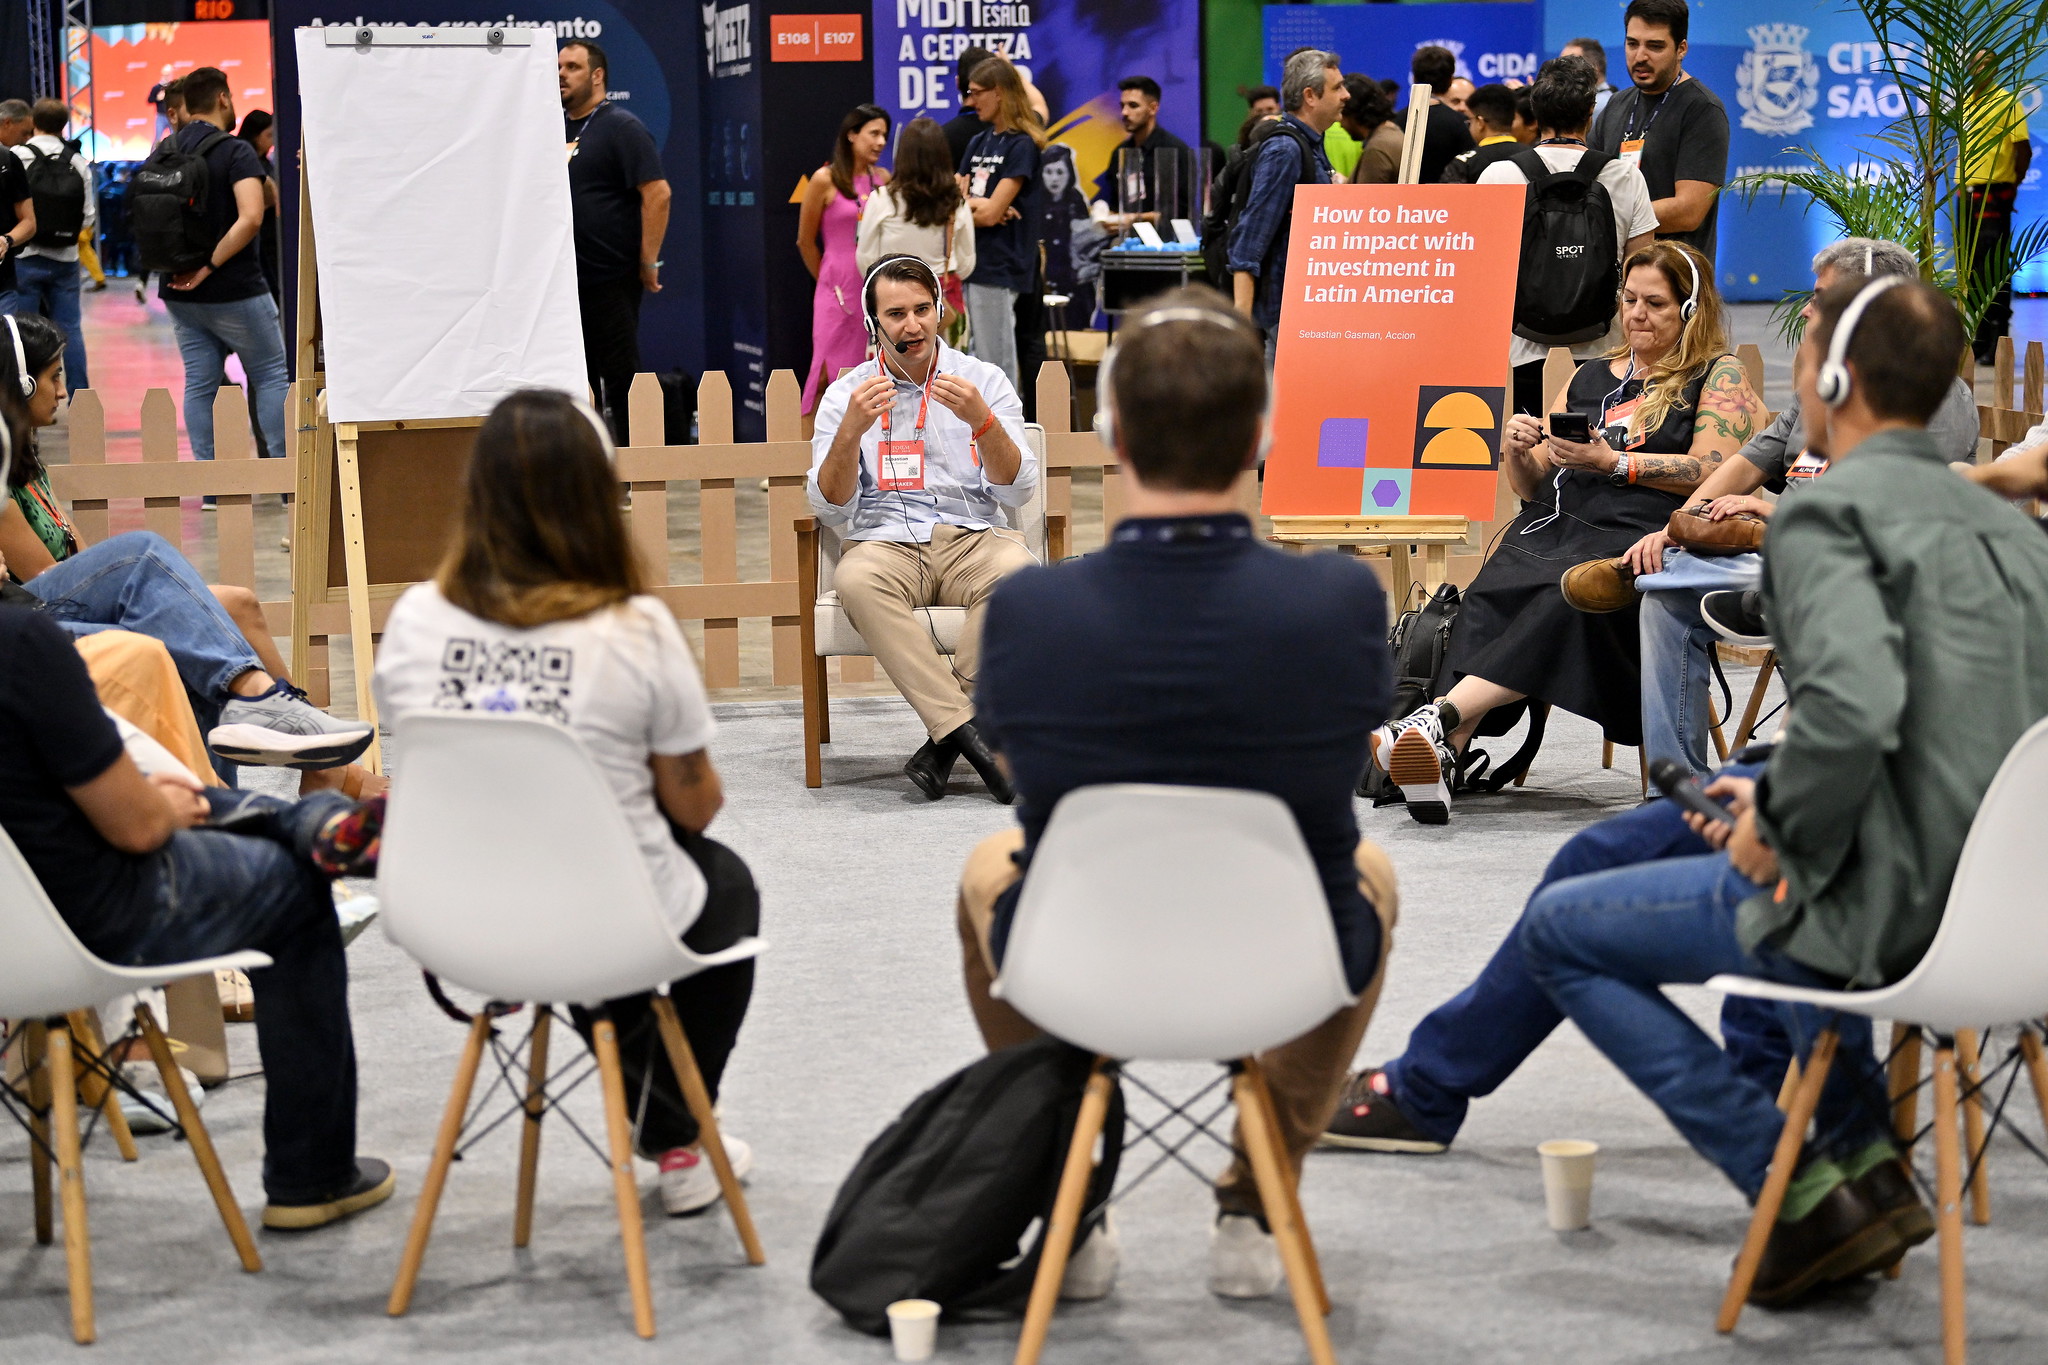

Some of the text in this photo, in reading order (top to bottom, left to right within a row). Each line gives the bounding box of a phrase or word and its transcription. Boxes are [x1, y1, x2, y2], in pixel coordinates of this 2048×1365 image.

[195, 0, 235, 19] RIO
[982, 4, 1032, 28] ESALQ
[714, 3, 751, 64] MEETZ
[777, 32, 855, 45] E108 E107
[898, 32, 1033, 61] A CERTEZA
[1827, 42, 1916, 74] CITY
[898, 65, 950, 109] DE
[1826, 77, 1907, 119] SÃO
[1313, 205, 1449, 224] How to have
[1309, 231, 1475, 254] an impact with
[1555, 245, 1585, 255] SPOT
[1306, 258, 1455, 277] investment in
[1303, 284, 1454, 304] Latin America
[1298, 330, 1416, 341] Sebastian Gasman, Accion
